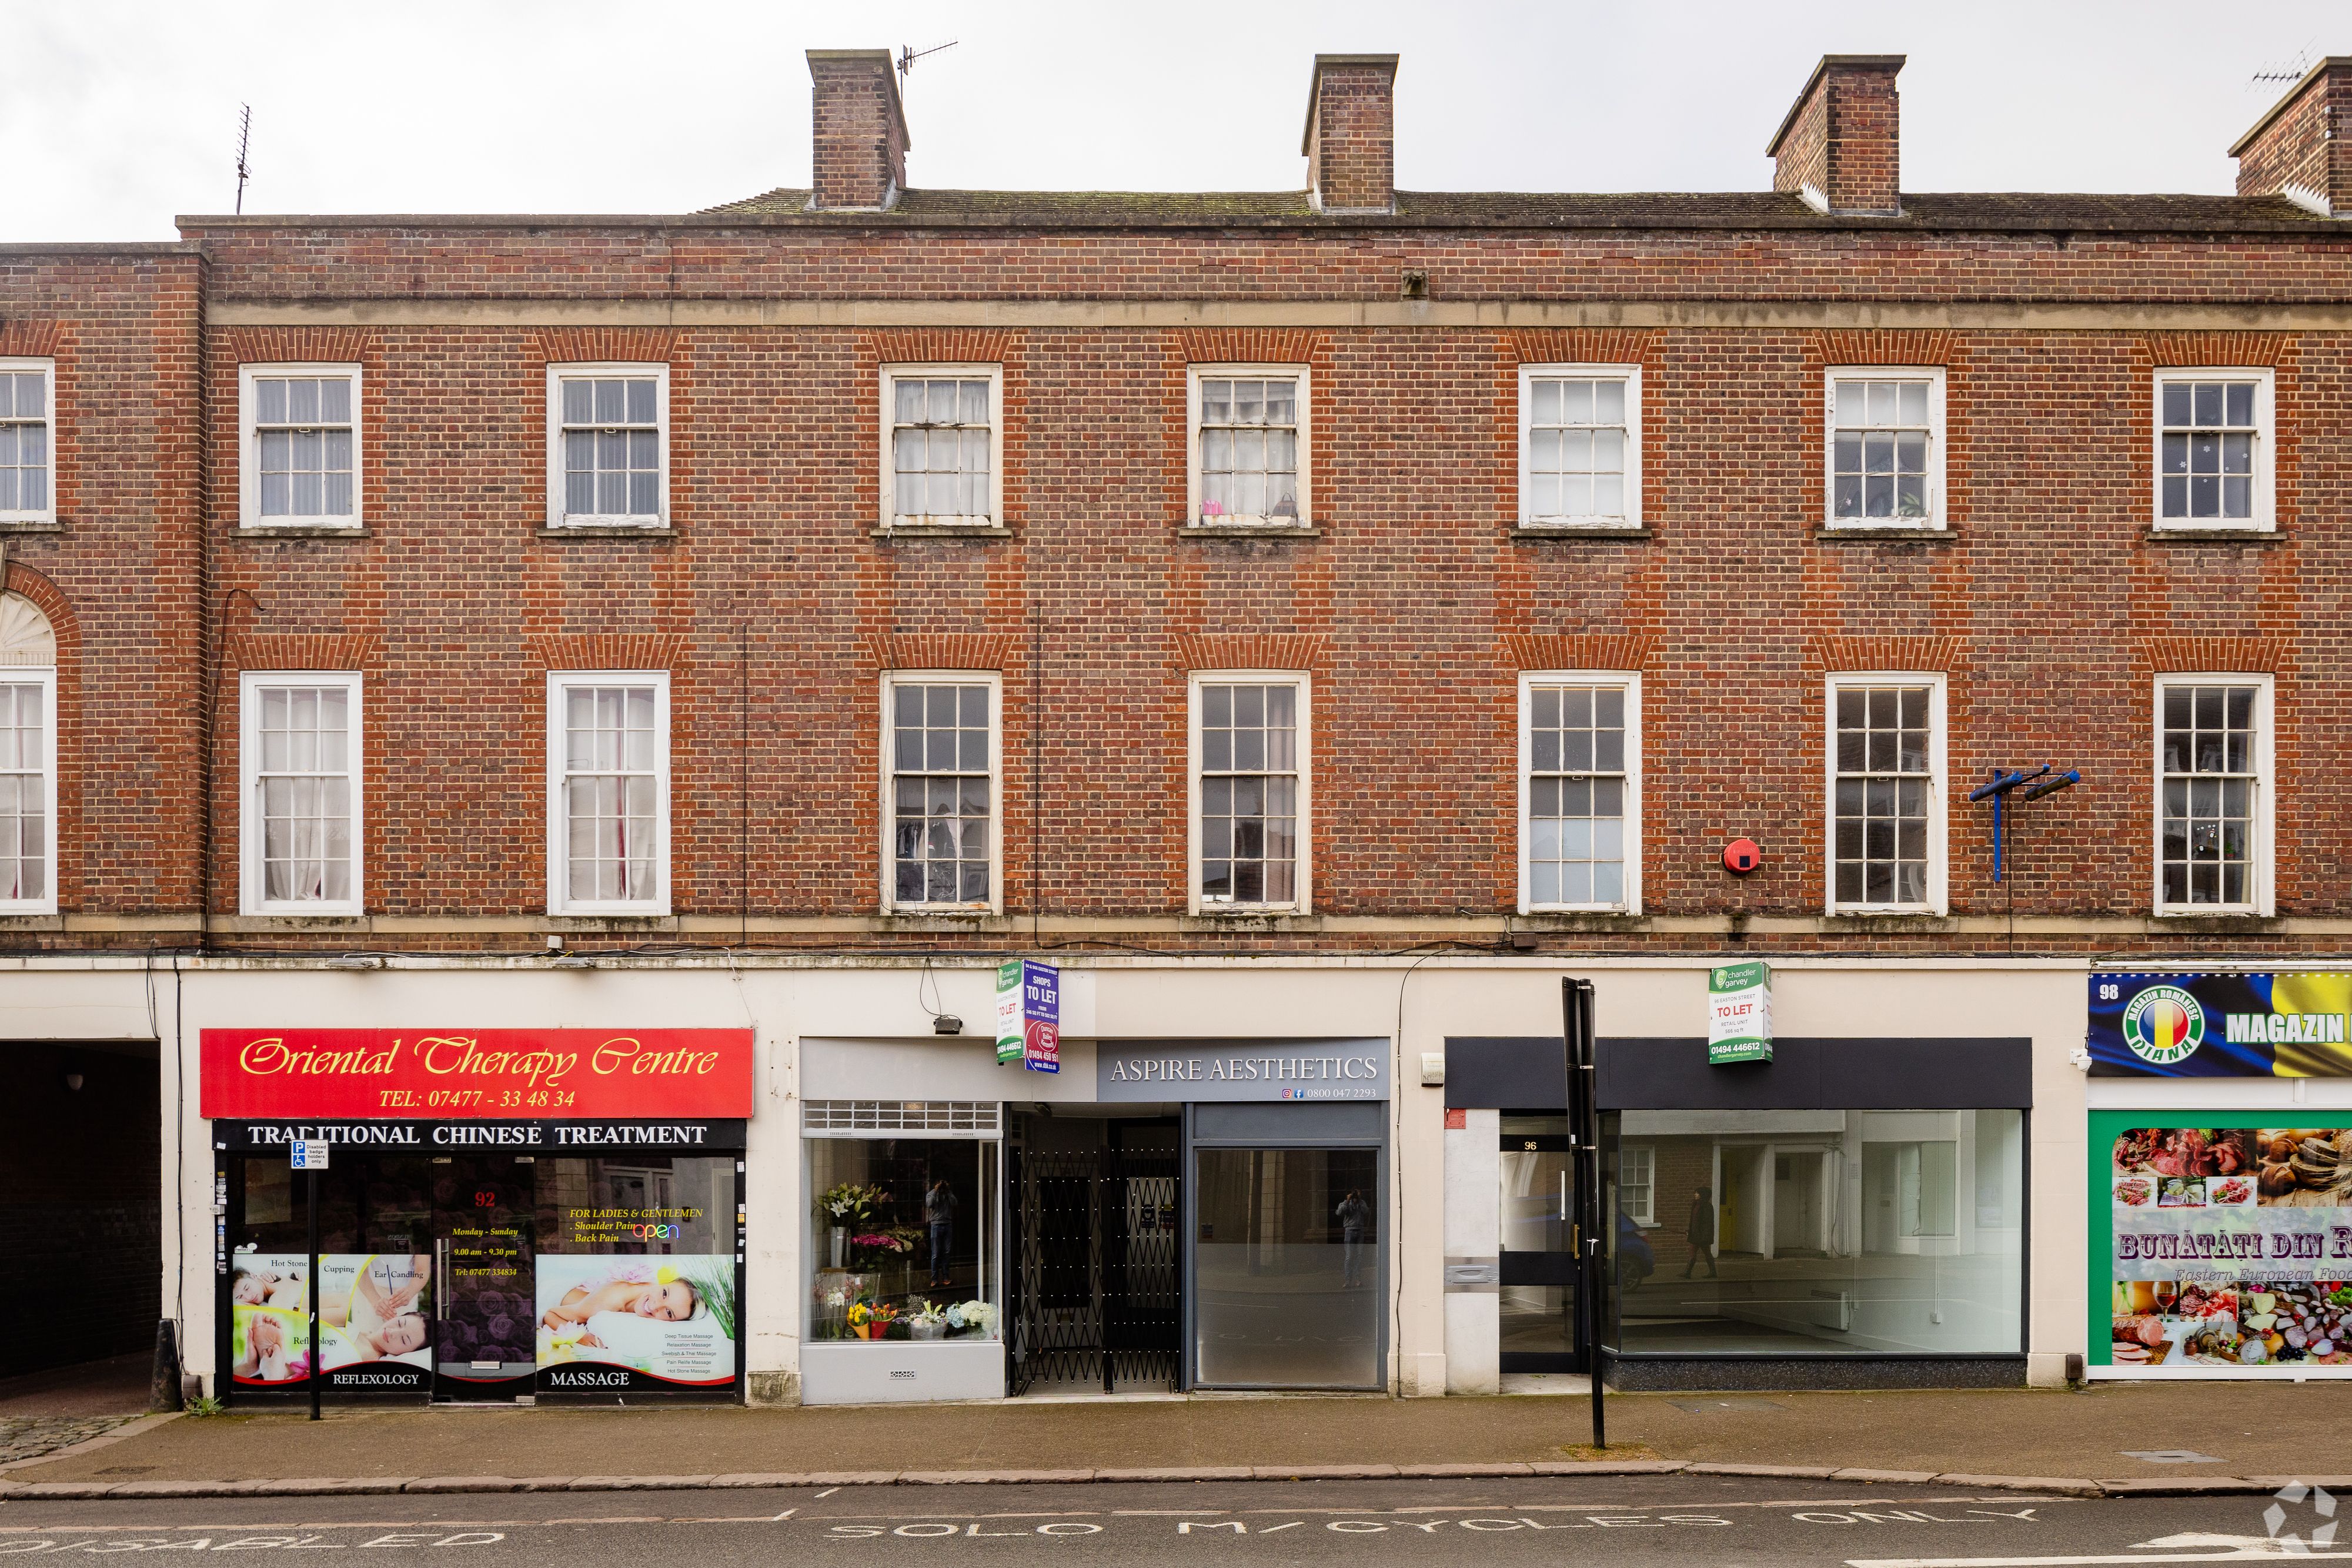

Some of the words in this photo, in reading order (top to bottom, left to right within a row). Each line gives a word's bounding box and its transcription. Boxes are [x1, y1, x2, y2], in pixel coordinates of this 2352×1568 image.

[1728, 969, 1756, 979] chandler
[1033, 975, 1051, 987] SHOPS
[1725, 978, 1748, 988] garvey
[1026, 985, 1039, 1001] TO
[1041, 988, 1057, 1005] LET
[2099, 984, 2119, 999] 98
[999, 1006, 1005, 1016] TO
[1005, 1002, 1017, 1015] LET
[1718, 1007, 1730, 1017] TO
[1733, 1003, 1753, 1015] LET
[2127, 990, 2159, 1021] MAGAZIN
[2160, 989, 2200, 1021] ROMÂNESC
[2226, 1014, 2344, 1043] MAGAZIN
[1028, 1049, 1043, 1059] 01494
[1043, 1051, 1051, 1061] 450
[1711, 1045, 1732, 1055] 01494
[1732, 1042, 1760, 1052] 446612
[2132, 1039, 2193, 1061] DIANA
[239, 1038, 402, 1075] Oriental
[414, 1037, 577, 1088] Therapy
[592, 1037, 719, 1075] Centre
[1110, 1059, 1203, 1081] ASPIRE
[1208, 1057, 1378, 1080] AESTHETICS
[379, 1091, 421, 1107] TEL:
[428, 1090, 483, 1107] 07477
[499, 1090, 521, 1107] 33
[527, 1090, 548, 1107] 48
[553, 1090, 576, 1107] 34
[1307, 1089, 1332, 1098] 0800
[1333, 1089, 1351, 1098] 047
[1353, 1088, 1377, 1097] 2293
[432, 1126, 542, 1144] CHINESE
[555, 1126, 707, 1144] TREATMENT
[1524, 1141, 1537, 1150] 96
[475, 1192, 496, 1207] 92
[569, 1209, 590, 1218] FOR
[593, 1209, 629, 1218] LADIES
[630, 1209, 639, 1218] &
[641, 1209, 704, 1218] GENTLEMEN
[574, 1221, 614, 1230] Shoulder
[615, 1222, 636, 1230] Pain
[452, 1228, 483, 1238] Monday
[490, 1228, 519, 1237] Sunday
[574, 1233, 597, 1242] Back
[599, 1234, 619, 1242] Pain
[633, 1224, 680, 1242] open
[2270, 1233, 2325, 1259] DIN
[505, 1249, 517, 1258] pm
[323, 1265, 355, 1274] Cupping
[390, 1271, 424, 1279] Candling
[2173, 1268, 2233, 1281] Eastern
[2237, 1268, 2315, 1281] European
[293, 1336, 338, 1346] Reflology
[333, 1374, 419, 1385] REFLEXOLOGY
[550, 1373, 630, 1386] MASSAGE
[1792, 1509, 2039, 1524] ONLY
[822, 1523, 1104, 1539] SOLO
